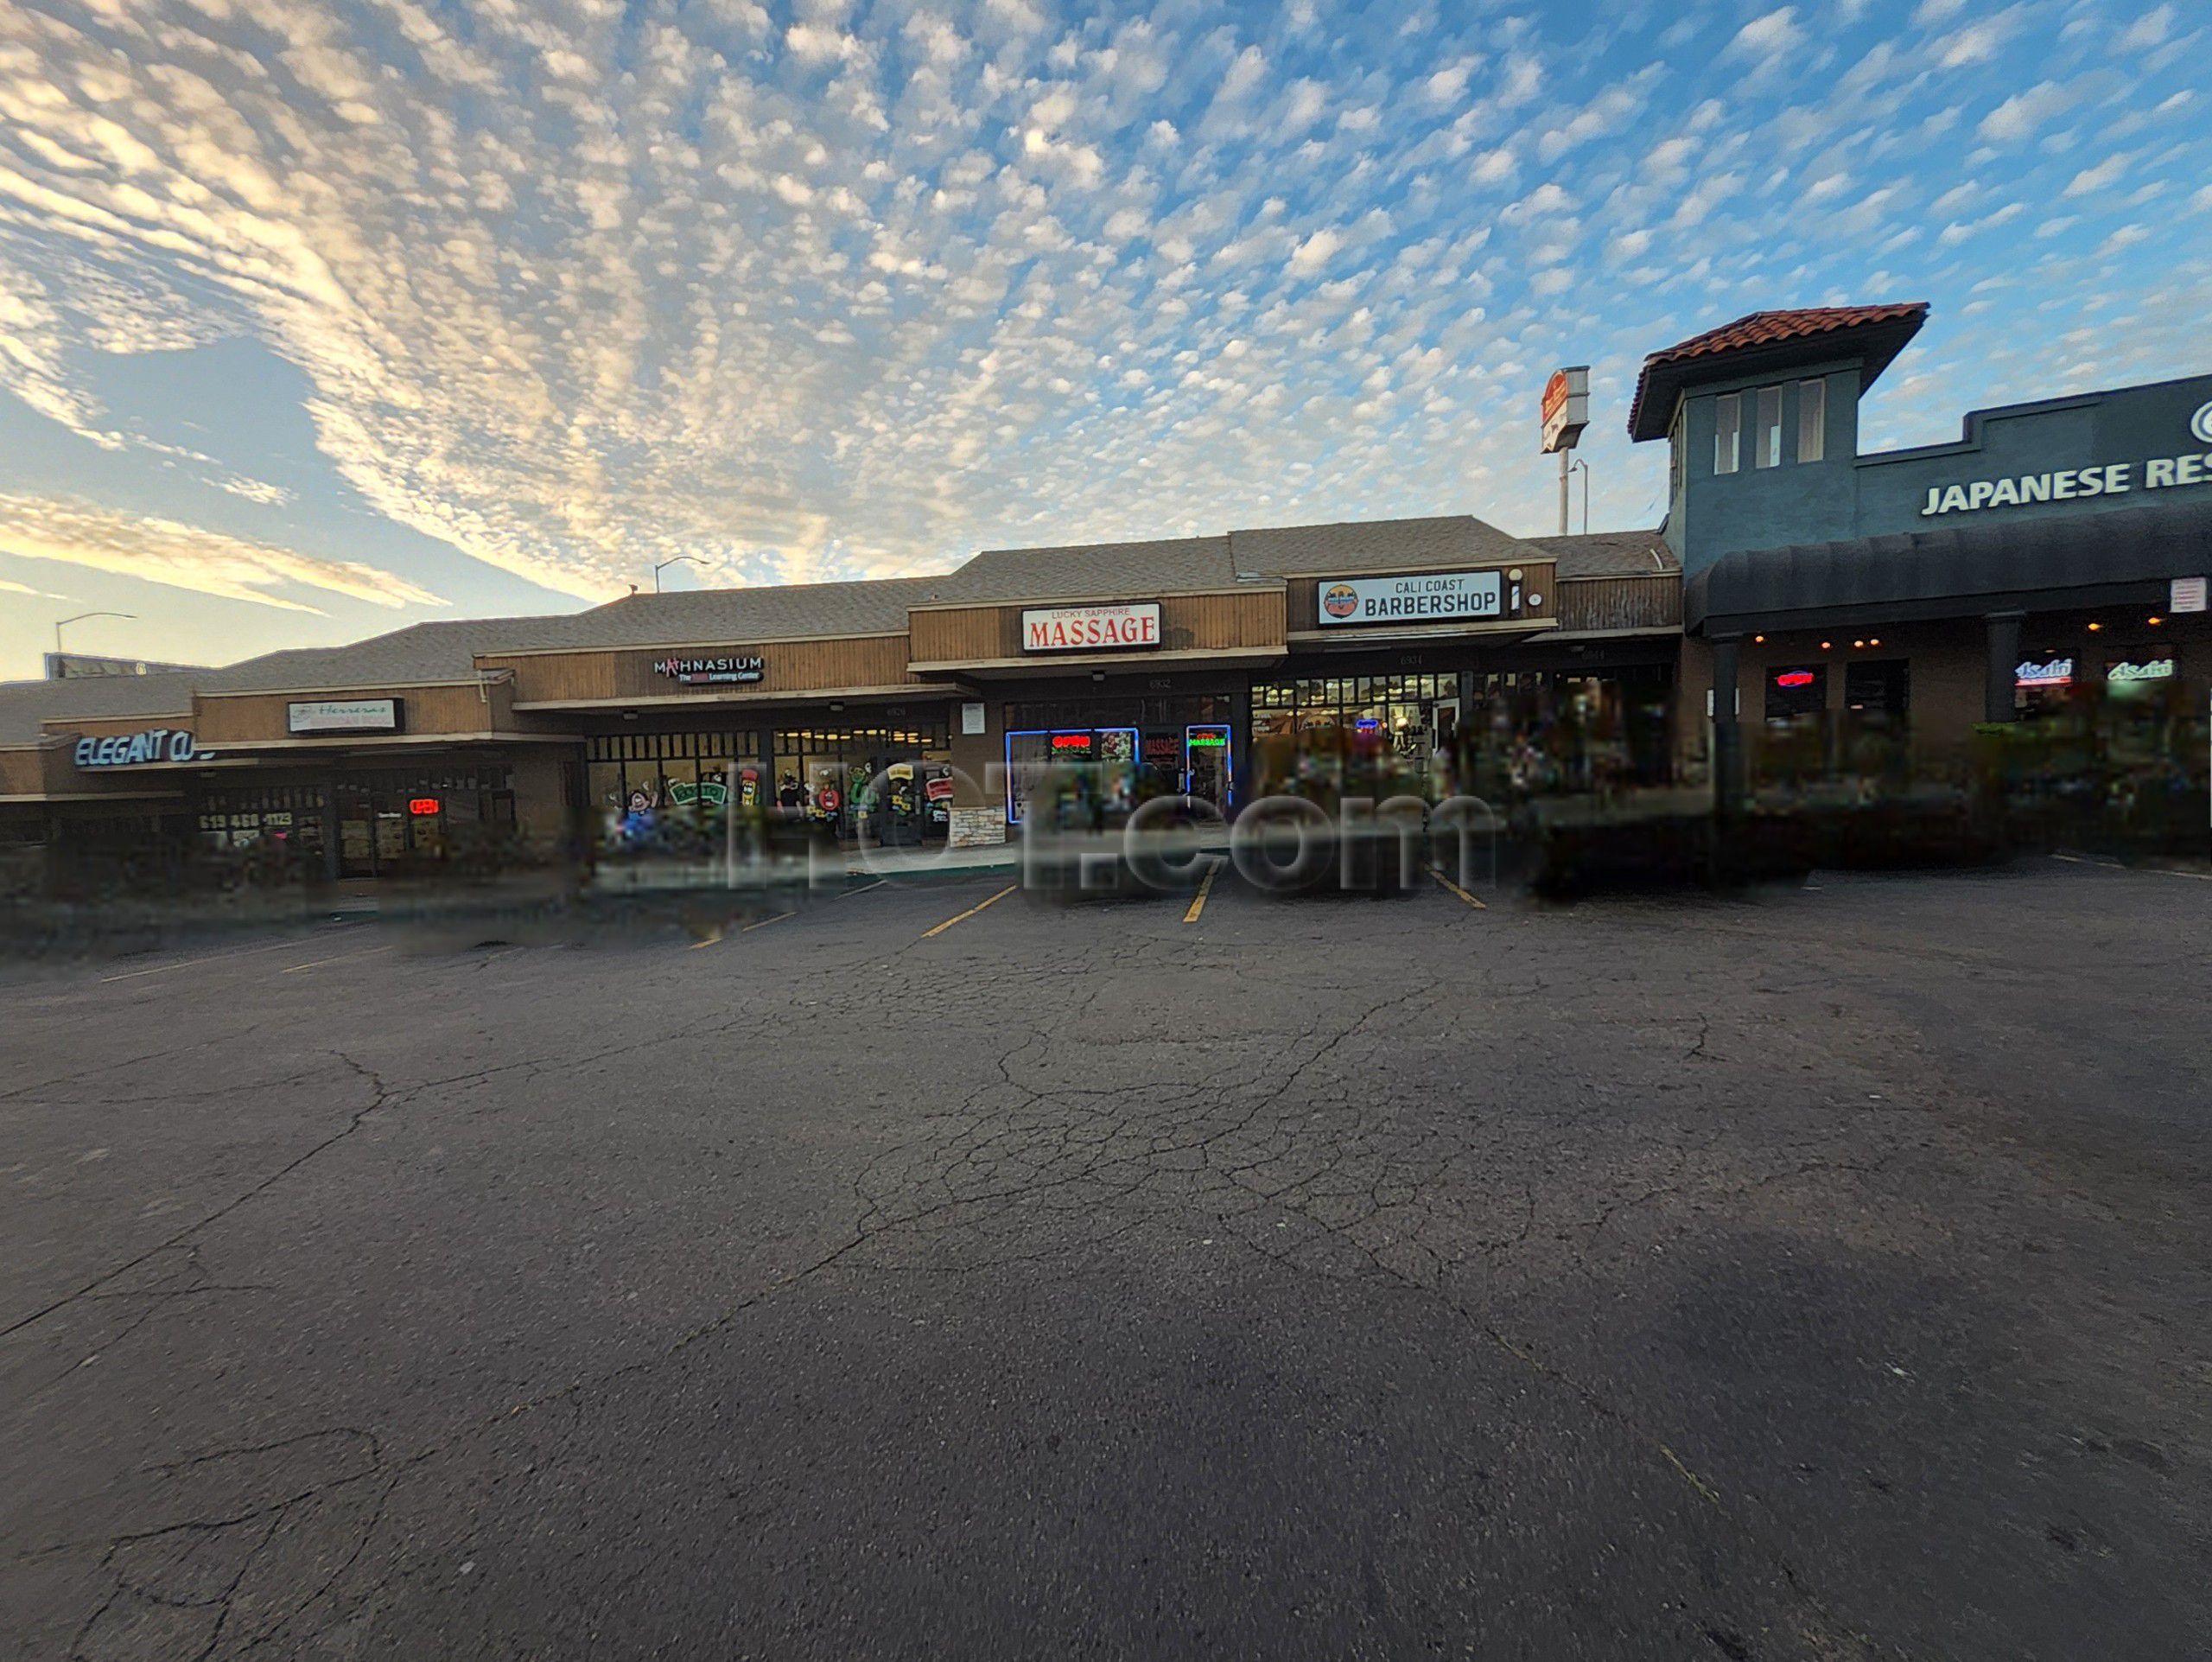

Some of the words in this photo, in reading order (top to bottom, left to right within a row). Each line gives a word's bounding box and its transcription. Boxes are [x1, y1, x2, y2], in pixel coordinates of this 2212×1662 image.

[1921, 467, 2131, 517] JAPANESE
[1395, 582, 1421, 597] CALI
[1425, 578, 1466, 595] COAST
[1051, 610, 1083, 620] LUCKY
[1084, 608, 1131, 617] SAPPHIRE
[1364, 592, 1497, 617] BARBERSHOP
[1029, 616, 1155, 647] MASSAGE
[654, 657, 763, 678] MATHNASIUM
[709, 672, 737, 681] Learning
[737, 671, 760, 679] Center
[75, 729, 168, 766] ELEGANT
[410, 799, 439, 814] OPEN
